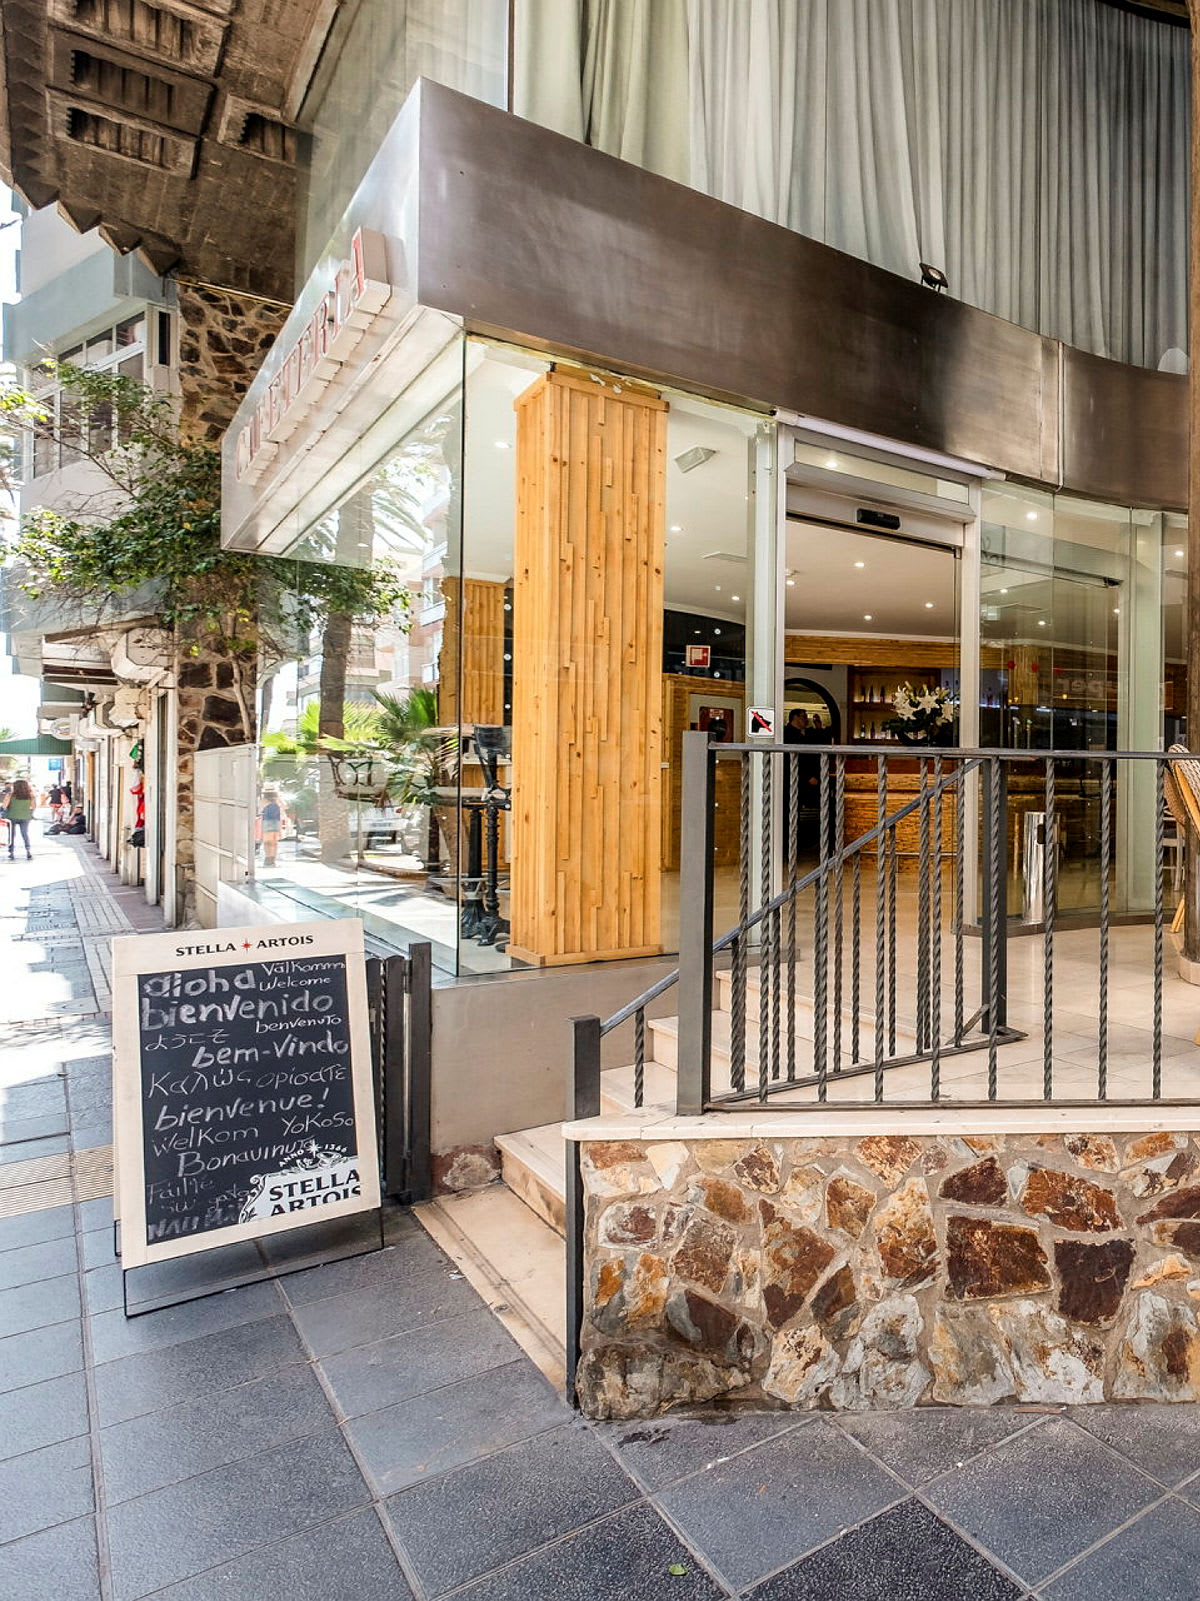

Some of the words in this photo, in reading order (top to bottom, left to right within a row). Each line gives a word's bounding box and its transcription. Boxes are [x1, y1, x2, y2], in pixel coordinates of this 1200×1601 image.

[176, 942, 237, 957] STELLA
[256, 934, 314, 949] ARTOIS
[141, 990, 333, 1031] bienvenido
[145, 1028, 230, 1051] ようこそ
[154, 1087, 330, 1131] bienvenue!
[279, 1149, 305, 1168] ANNO
[324, 1143, 348, 1153] 1366
[269, 1168, 360, 1202] STELLA
